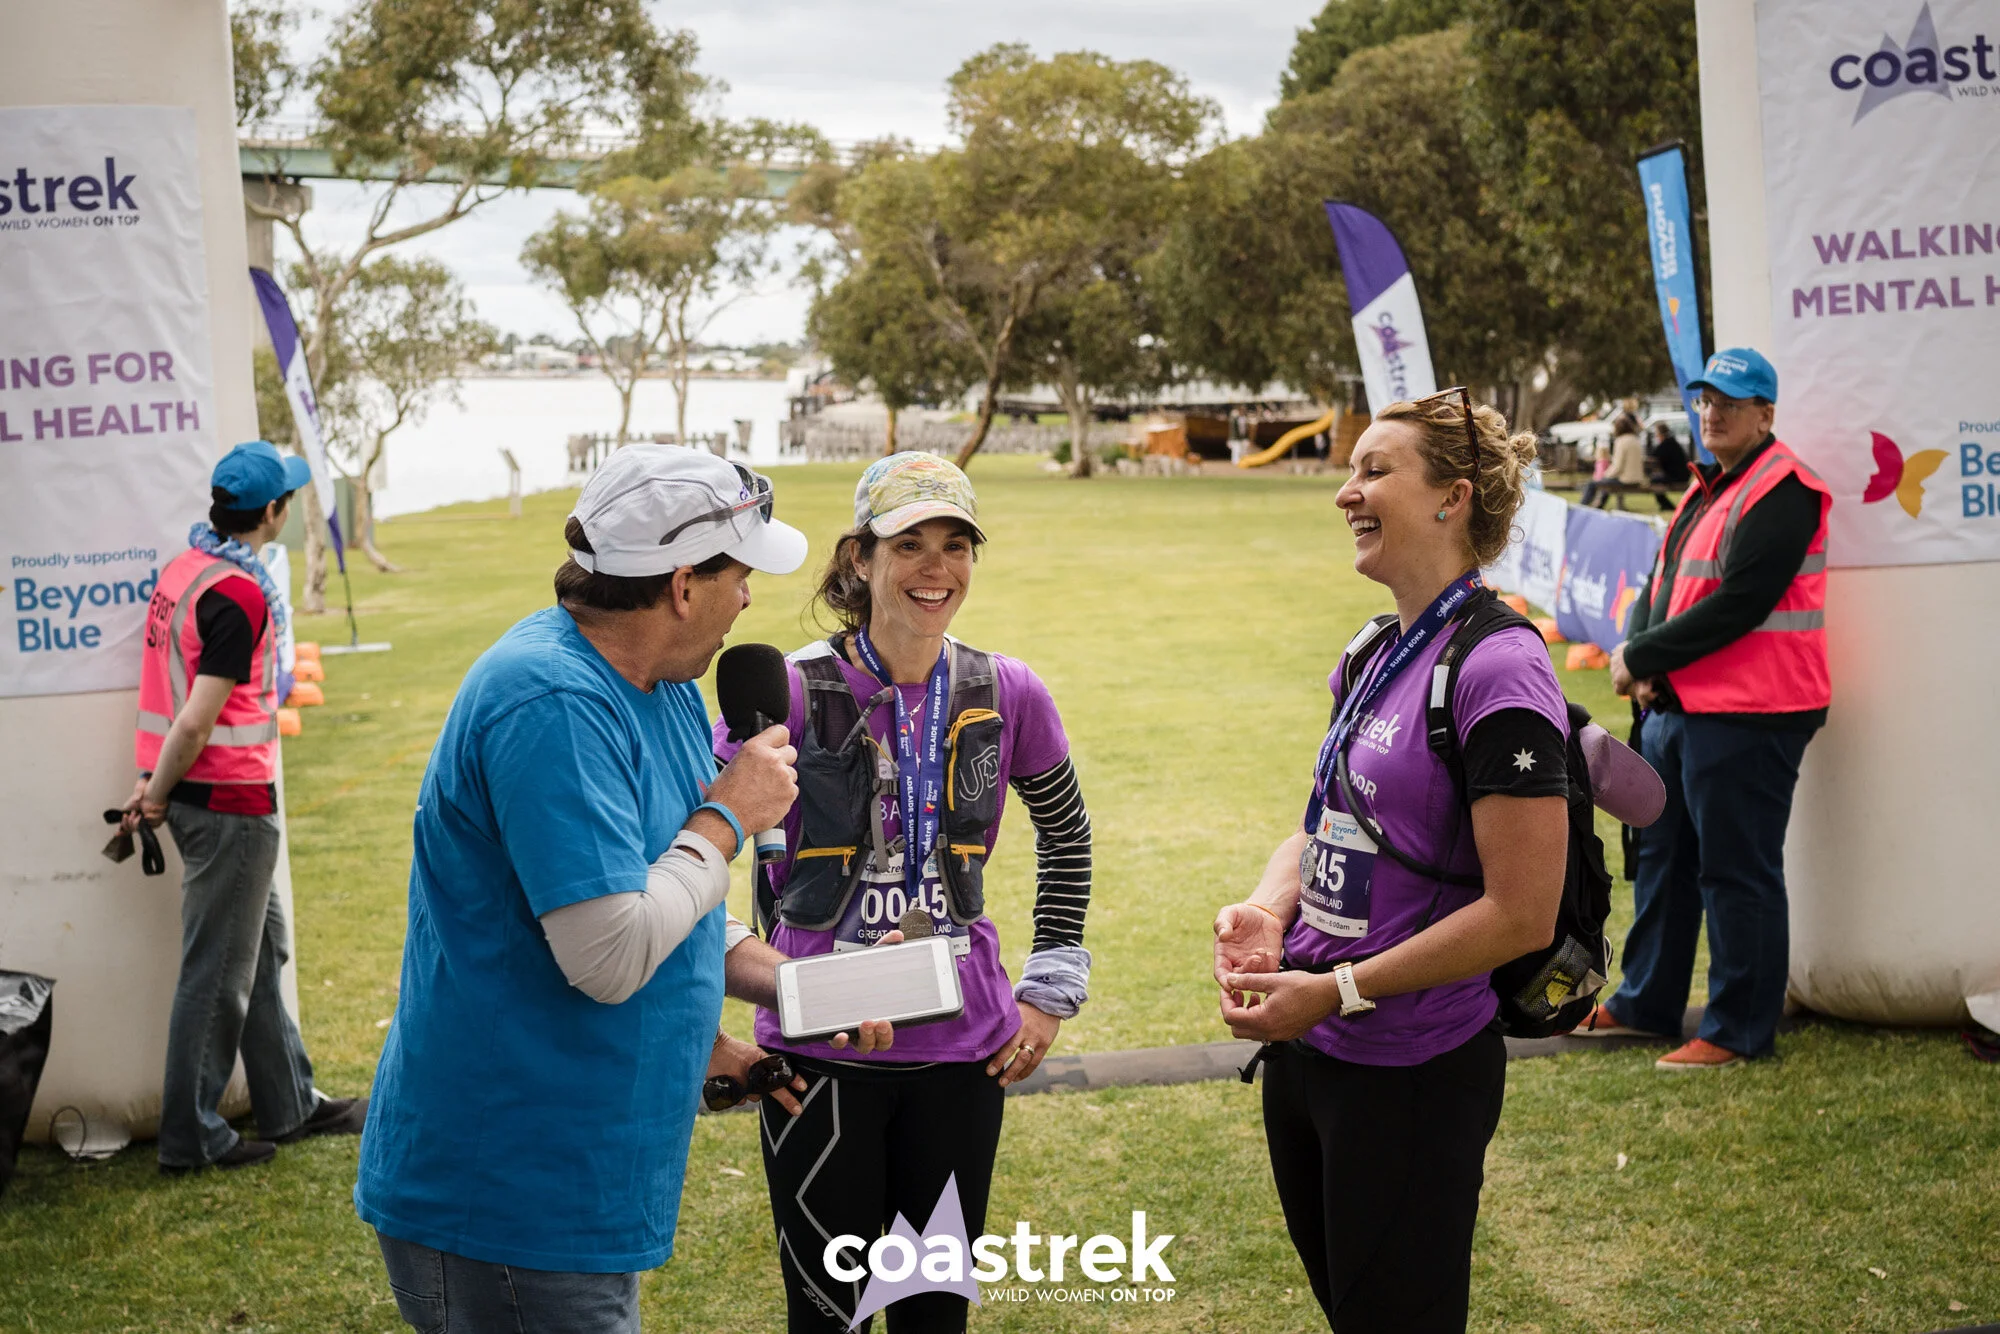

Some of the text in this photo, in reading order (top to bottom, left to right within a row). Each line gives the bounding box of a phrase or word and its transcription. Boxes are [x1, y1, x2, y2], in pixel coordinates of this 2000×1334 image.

[1830, 35, 2000, 90] coast
[1957, 86, 1989, 97] WILD
[0, 214, 140, 231] WILD WOMEN ON TOP
[1812, 223, 2000, 265] WALKIN
[1792, 276, 1975, 318] MENTAL
[88, 352, 175, 384] FOR
[0, 401, 200, 442] L HEALTH
[1961, 483, 2000, 518] Bl
[12, 547, 157, 568] Proudly supporting
[14, 569, 158, 619] Beyond
[17, 617, 102, 653] Blue
[1389, 647, 1411, 668] SUPER
[1408, 629, 1426, 648] 60KM
[932, 696, 941, 720] SUPER
[929, 725, 938, 762] ADELAIDE
[906, 775, 914, 813] ADELAIDE
[1331, 822, 1358, 836] Beyond
[1331, 832, 1344, 841] Blue
[1314, 845, 1346, 892] 45
[1325, 896, 1343, 910] LAND
[933, 924, 952, 935] LAND
[802, 1286, 836, 1317] 2XU
